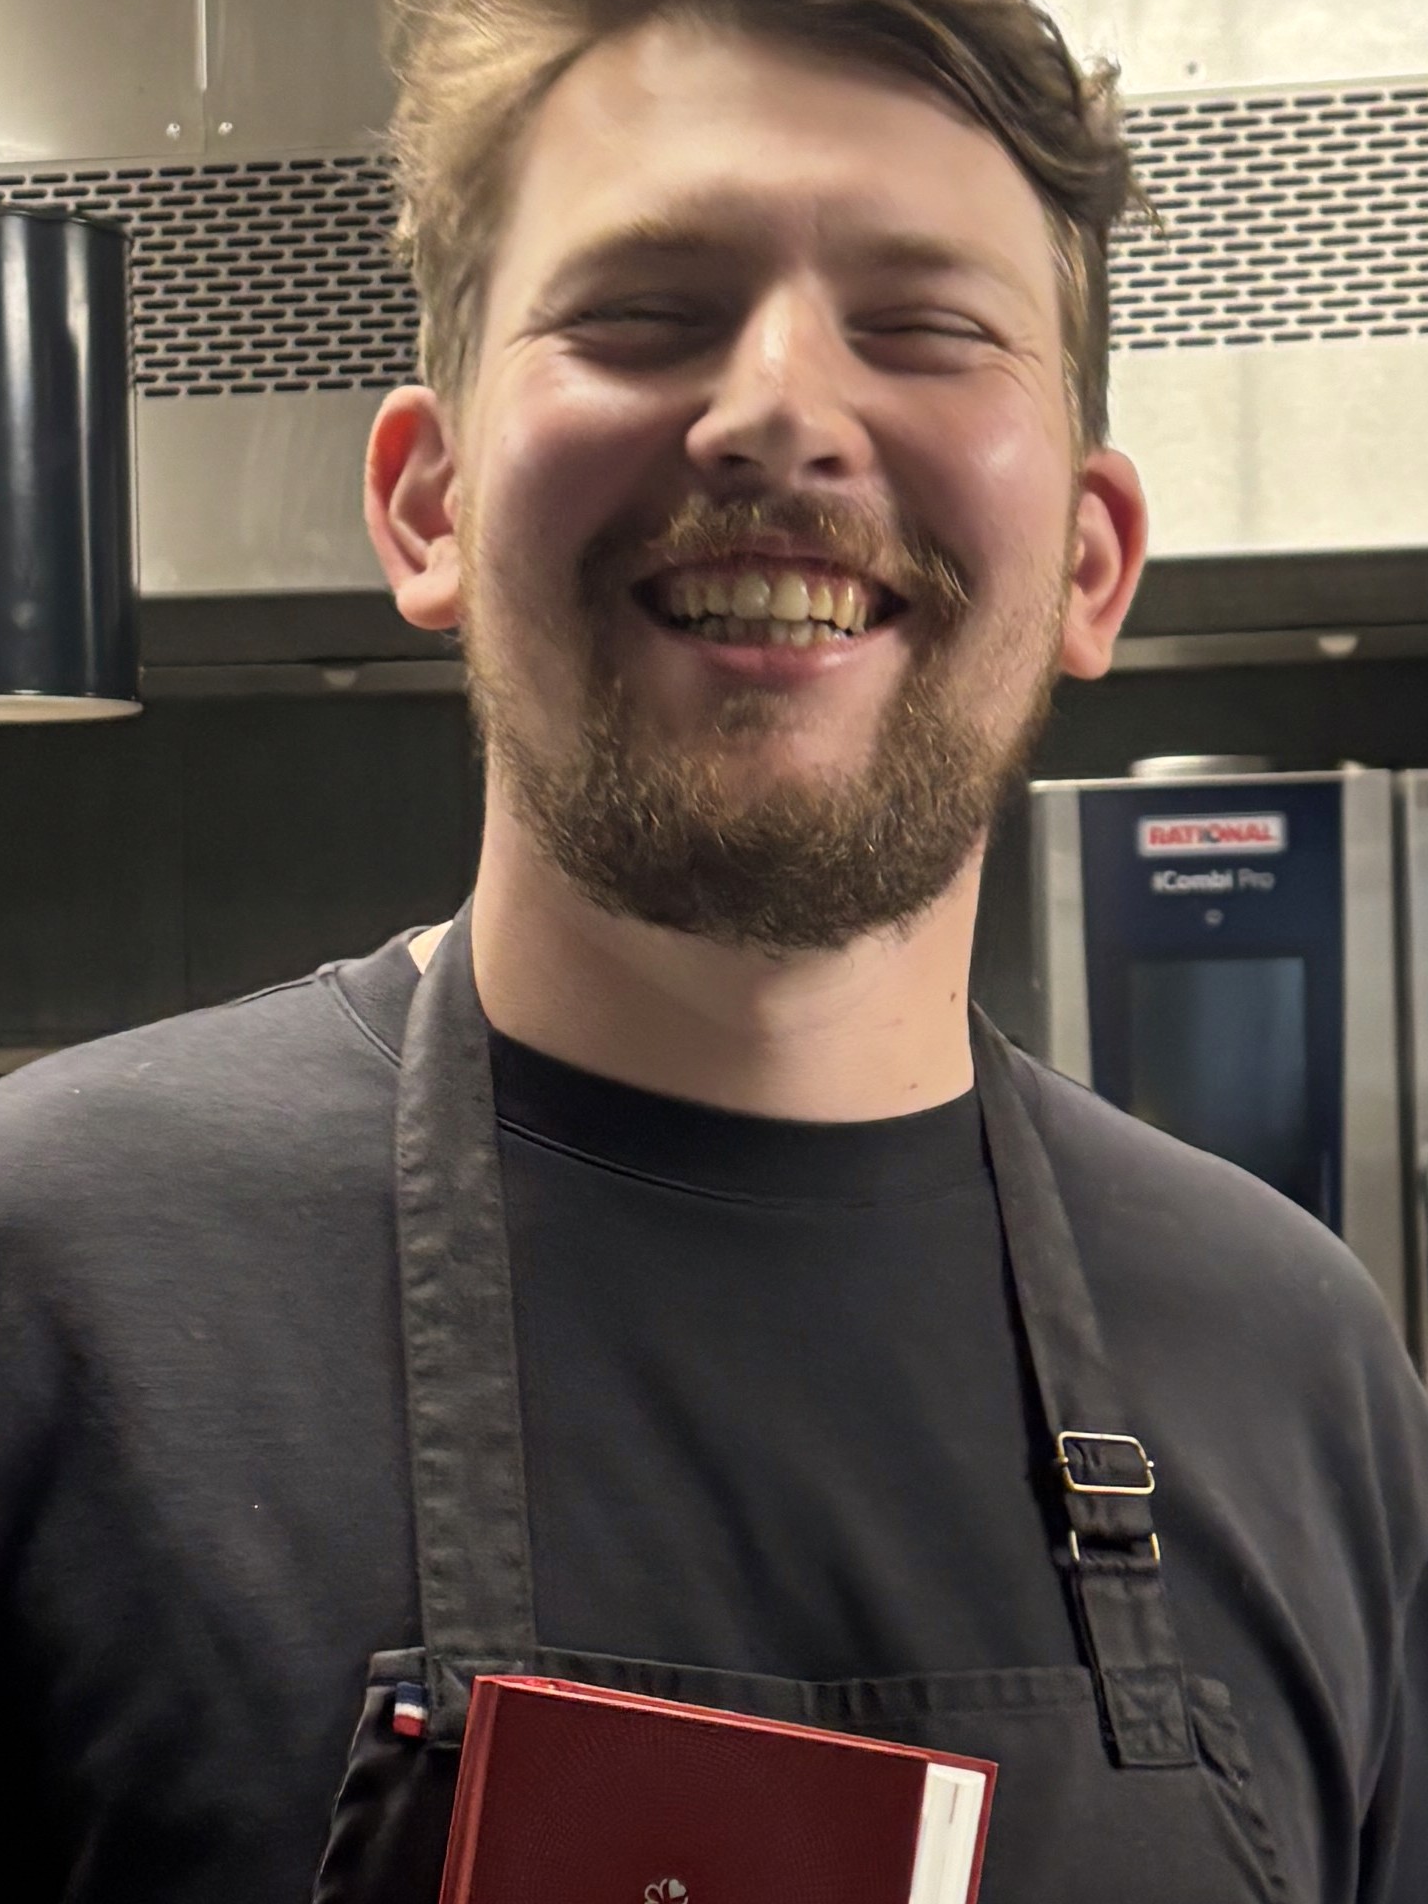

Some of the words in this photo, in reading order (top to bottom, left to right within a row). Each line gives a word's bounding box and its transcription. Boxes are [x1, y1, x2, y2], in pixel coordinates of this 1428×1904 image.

[1149, 823, 1276, 845] RATIONAL
[1152, 869, 1233, 893] iCombi
[1237, 867, 1275, 891] Pro
